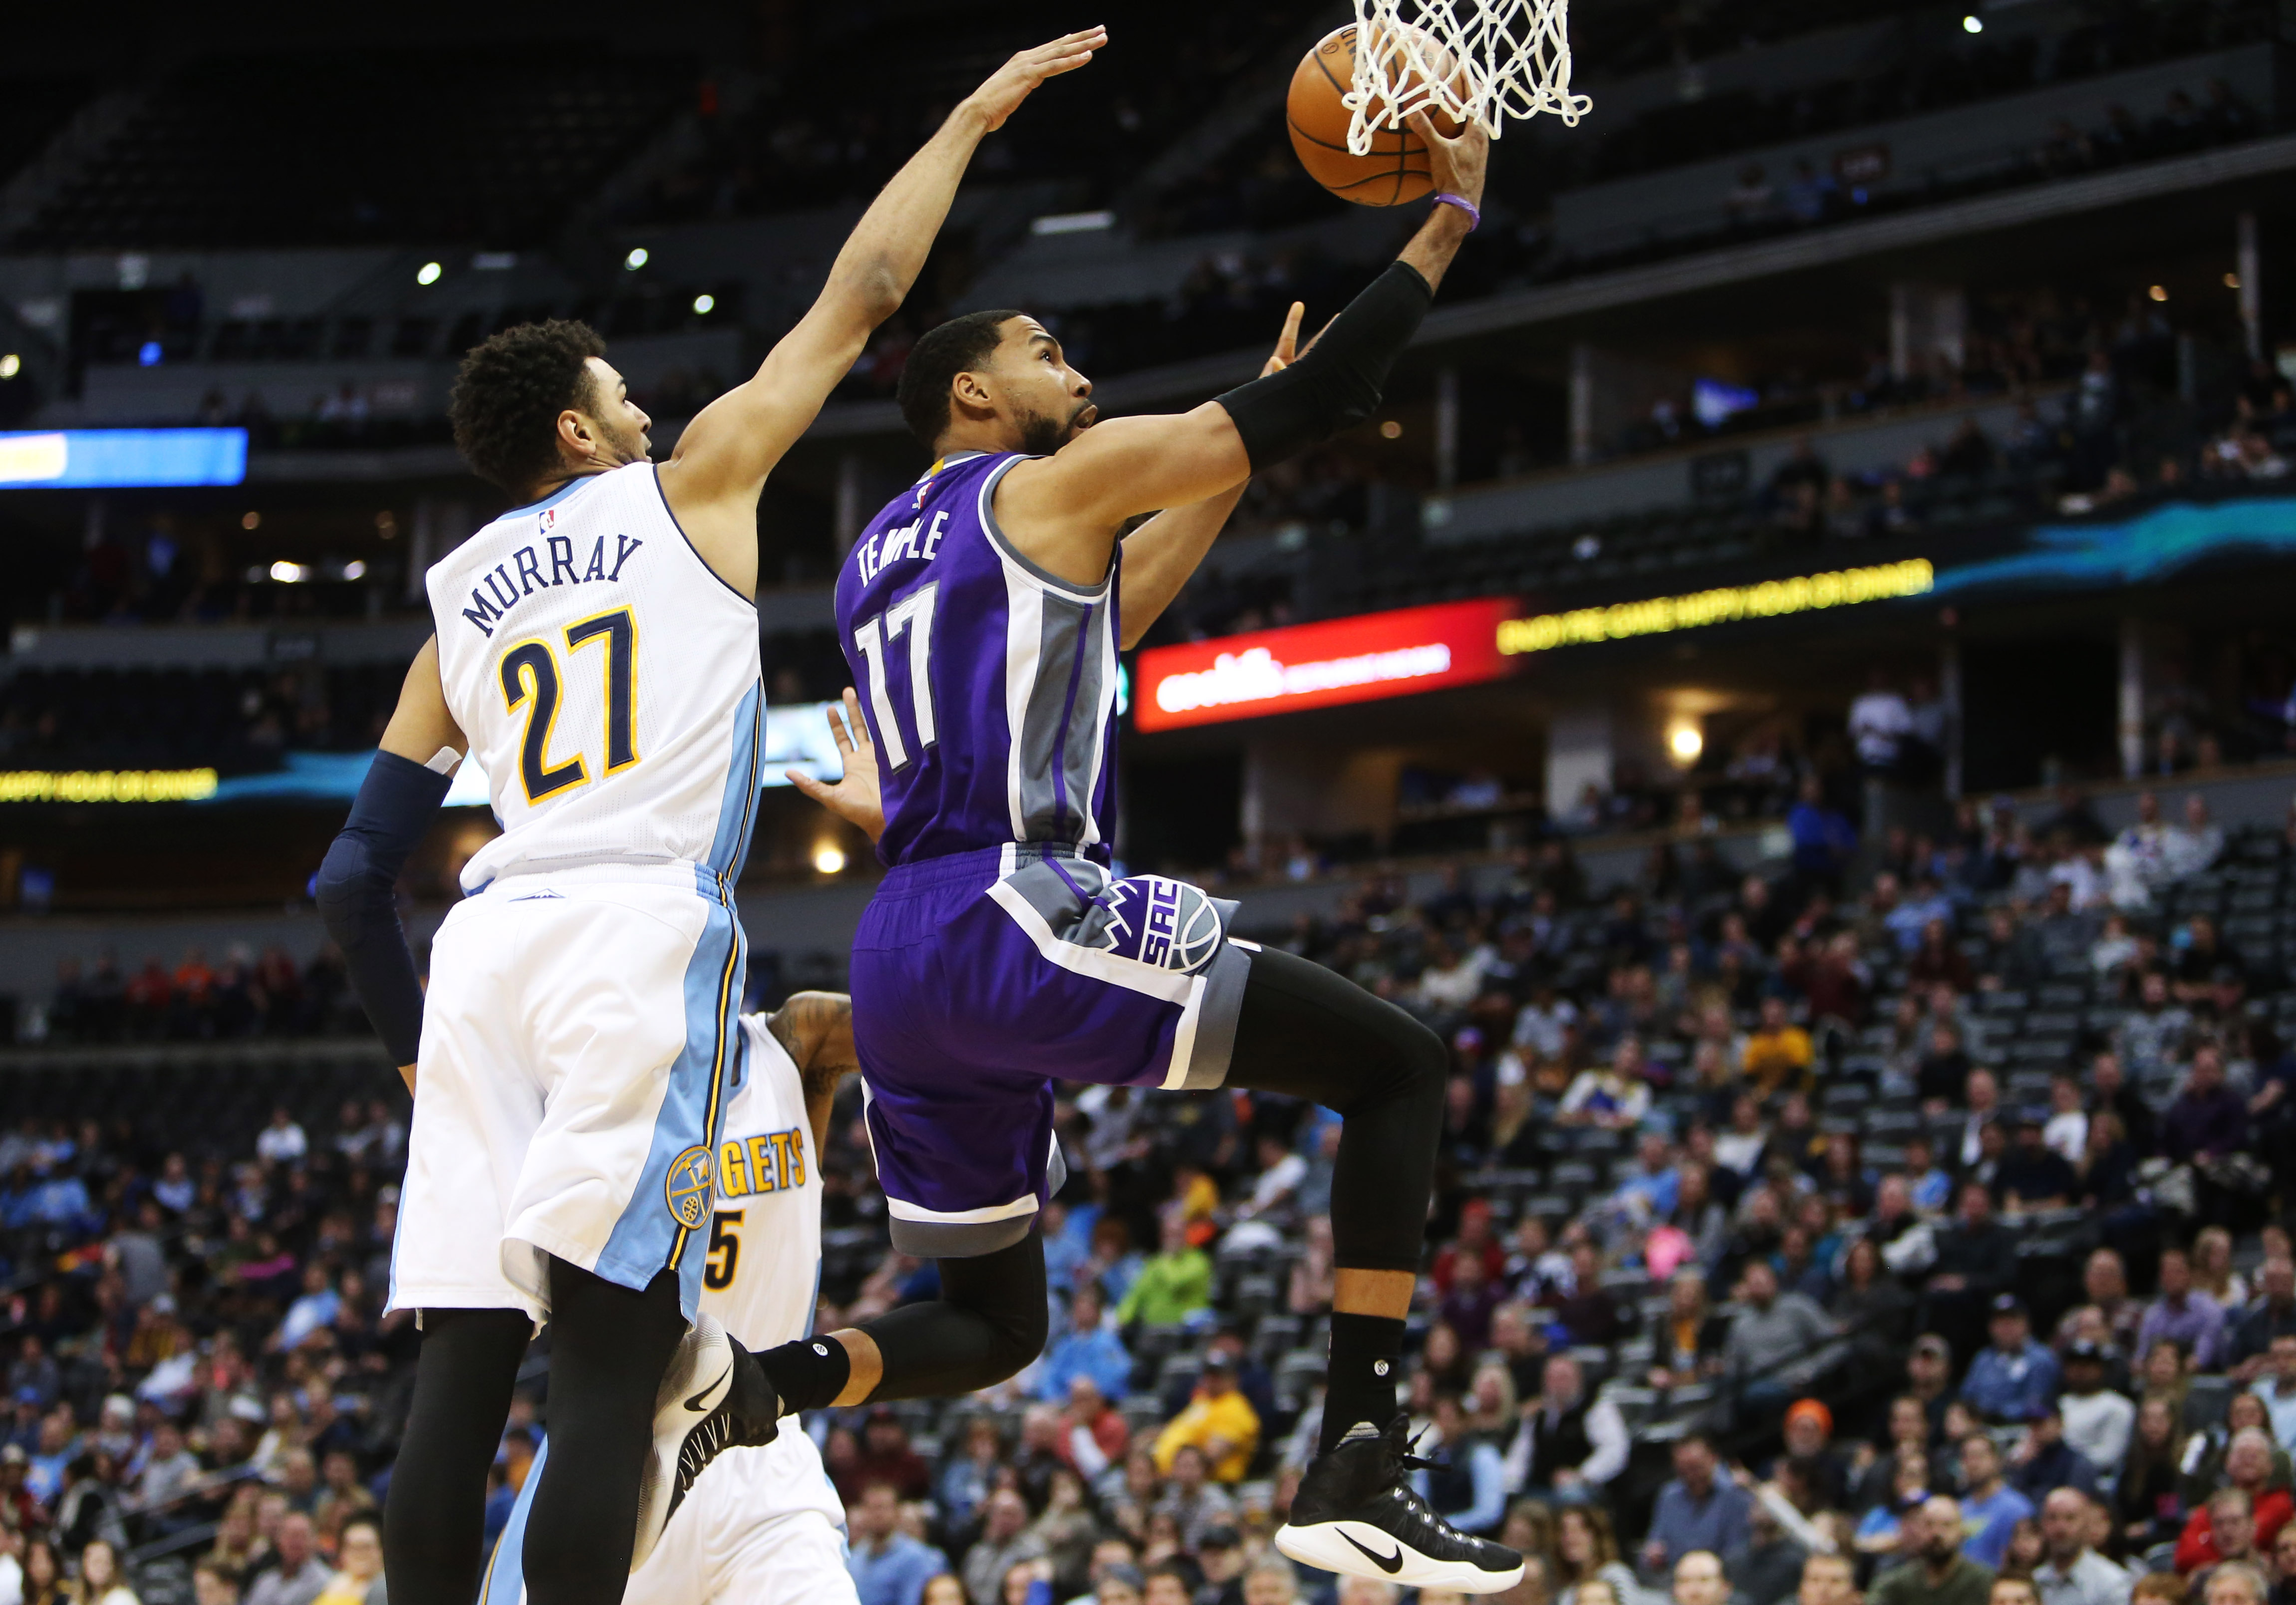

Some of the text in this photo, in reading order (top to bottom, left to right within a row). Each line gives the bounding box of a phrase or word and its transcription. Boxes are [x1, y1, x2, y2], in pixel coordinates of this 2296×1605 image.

[462, 534, 643, 638] MURRAY
[499, 603, 642, 807] 27
[854, 579, 939, 776] 17
[1142, 881, 1177, 968] SAC
[717, 1126, 806, 1199] GETS
[702, 1208, 747, 1293] 5
